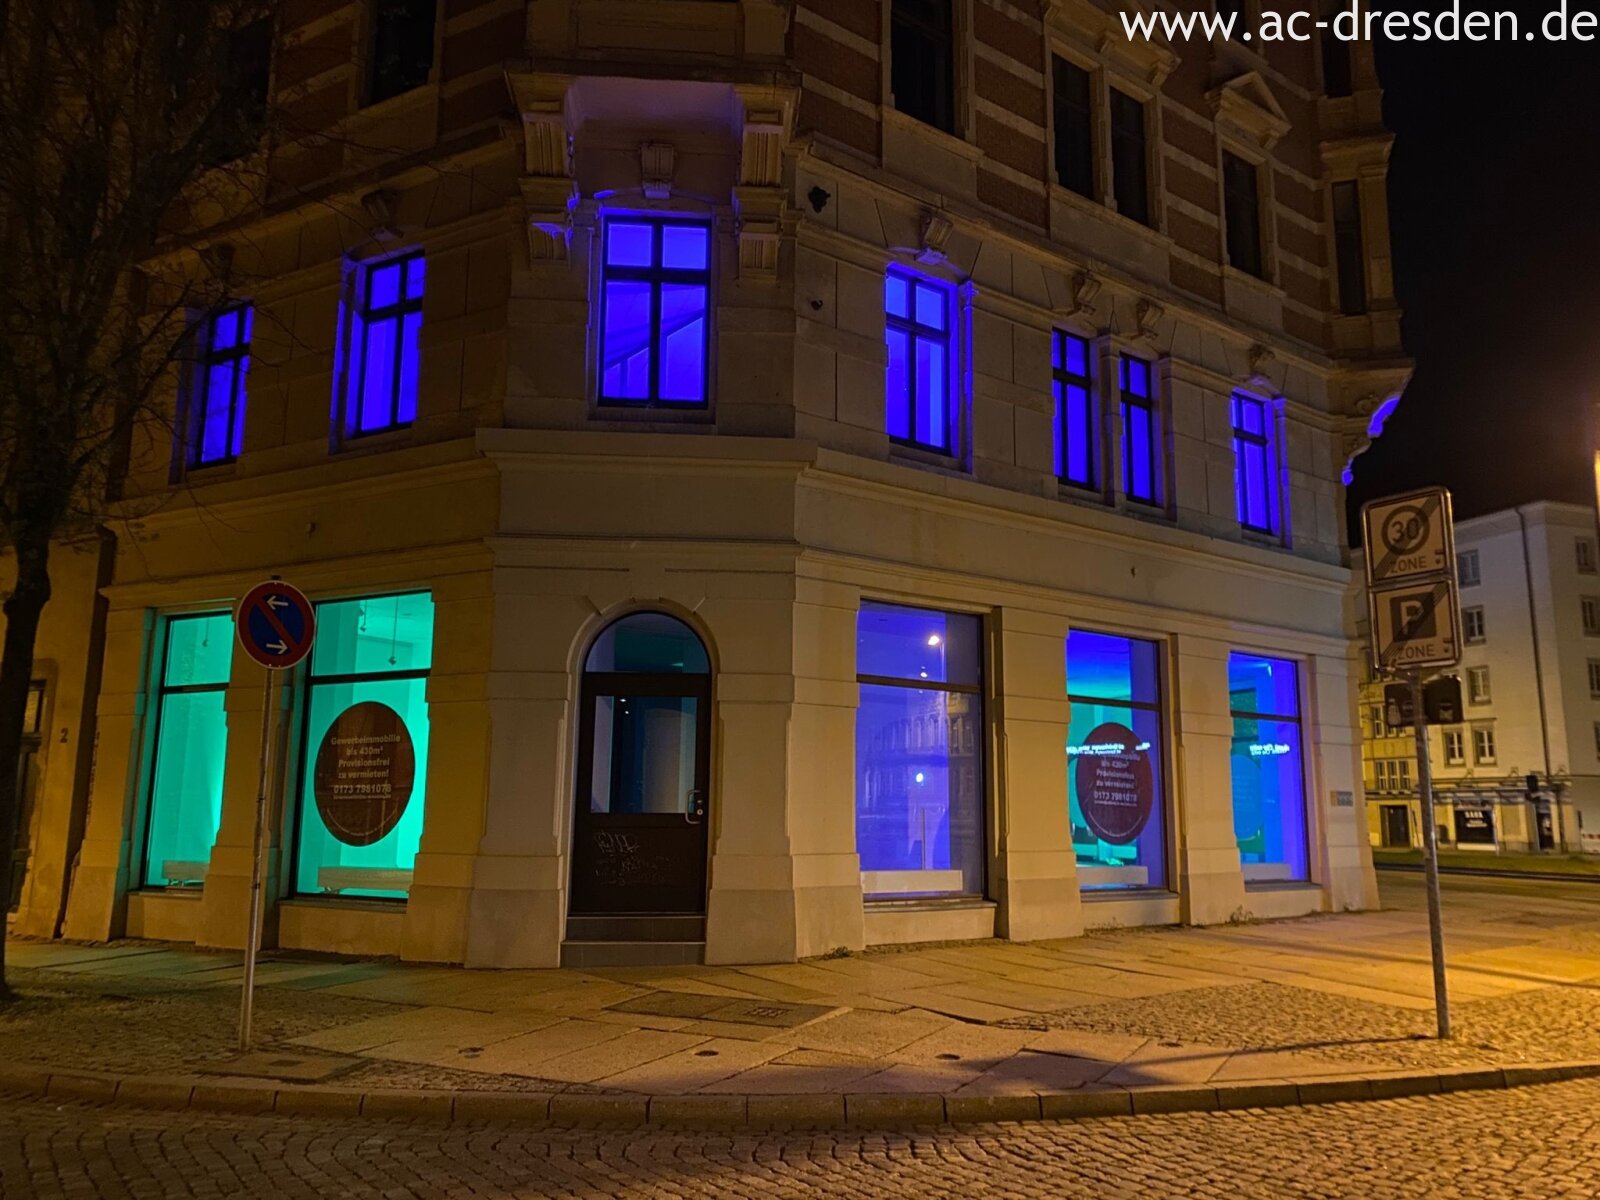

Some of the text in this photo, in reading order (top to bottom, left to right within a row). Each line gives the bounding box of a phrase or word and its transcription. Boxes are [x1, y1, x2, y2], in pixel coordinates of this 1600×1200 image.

[1390, 517, 1420, 544] 30
[1390, 555, 1427, 574] ZONE
[1401, 600, 1424, 635] P
[1397, 643, 1435, 660] ZONE
[60, 727, 69, 744] 2
[331, 735, 401, 745] Gewerbeimmobilie
[346, 747, 358, 756] bis
[338, 758, 390, 767] Provisionsfrei
[348, 769, 389, 779] vermieten!
[333, 784, 353, 794] 0173
[1094, 791, 1110, 800] 0173
